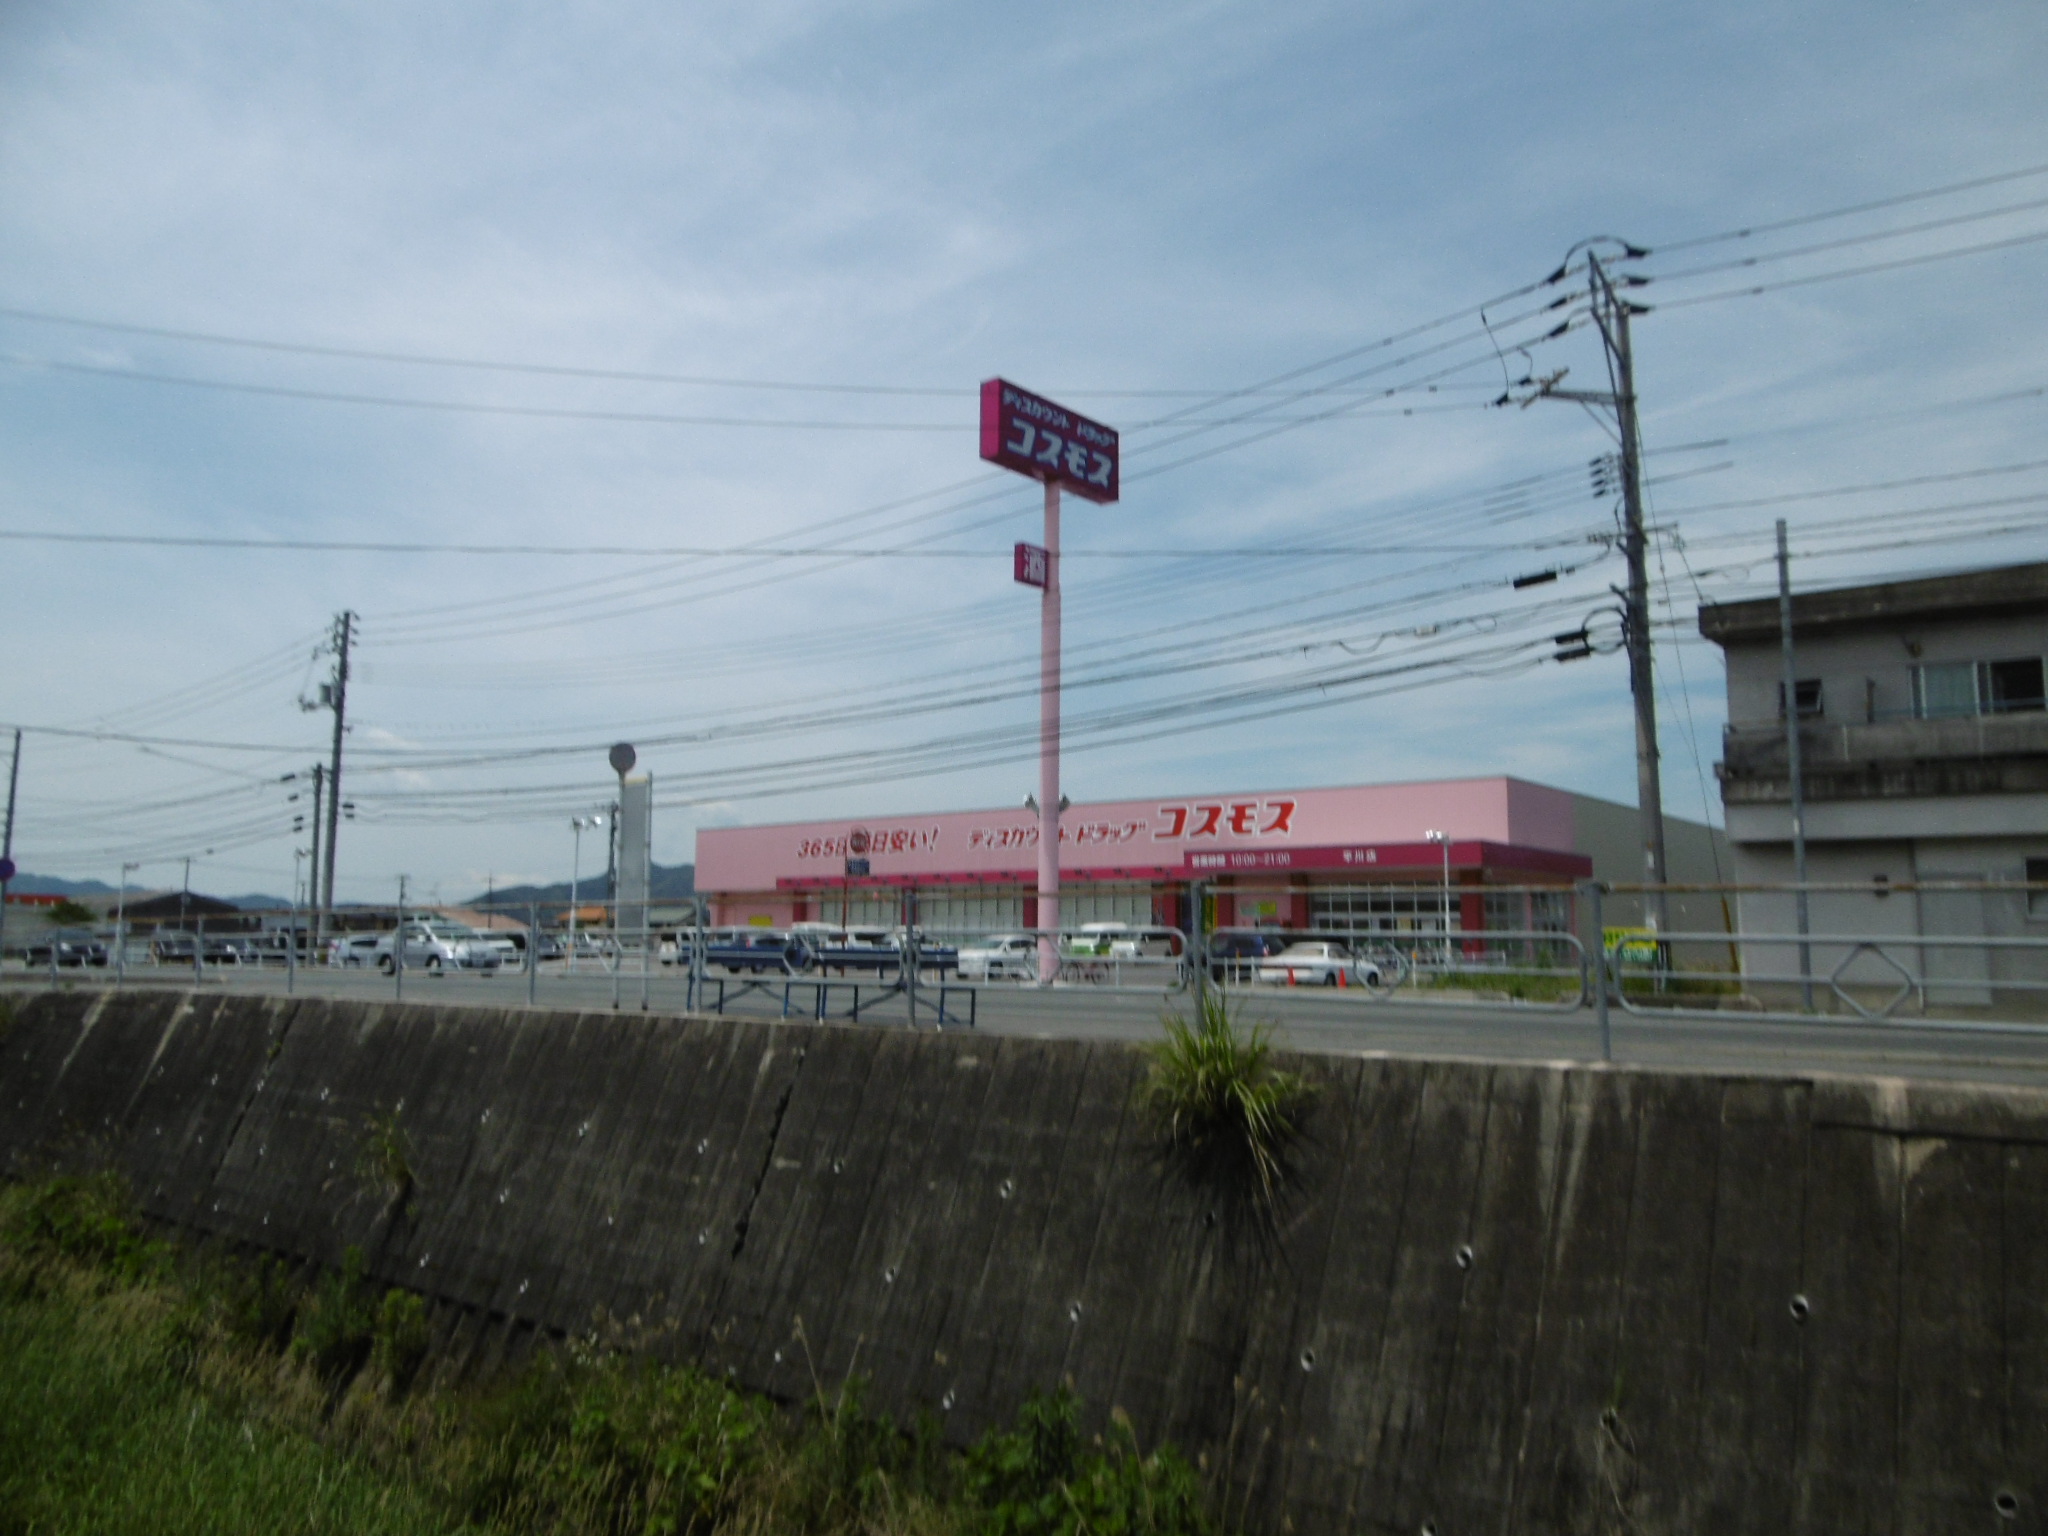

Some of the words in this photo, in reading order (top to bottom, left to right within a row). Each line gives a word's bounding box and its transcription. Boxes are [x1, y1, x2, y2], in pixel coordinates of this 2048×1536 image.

[1006, 416, 1113, 489] コスモス
[969, 824, 1071, 850] ディスカウト
[1075, 820, 1147, 846] ドラッグ
[1153, 800, 1297, 841] コスモス
[797, 825, 940, 858] 365日日安い!
